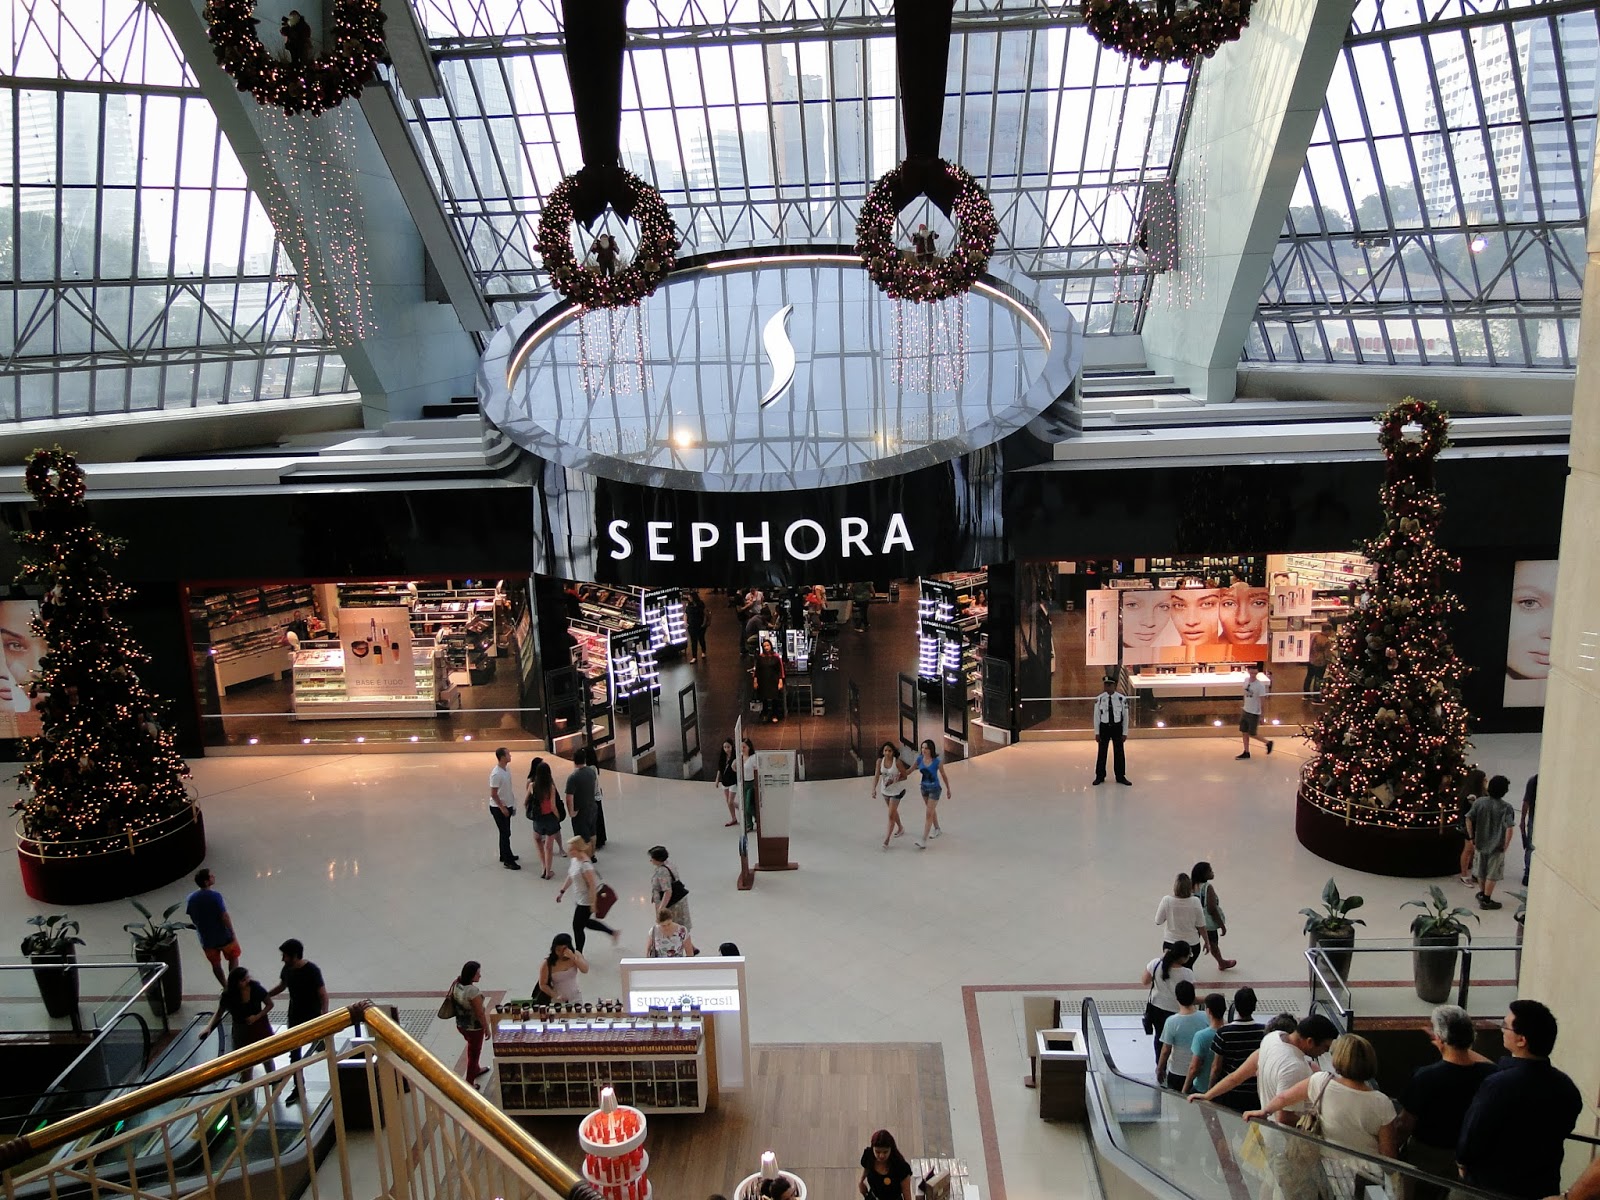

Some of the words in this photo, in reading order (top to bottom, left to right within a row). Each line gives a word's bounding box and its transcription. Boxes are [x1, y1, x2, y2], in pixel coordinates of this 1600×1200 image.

[608, 513, 914, 561] SEPHORA
[637, 996, 676, 1006] SURYA
[697, 996, 733, 1006] Brasil
